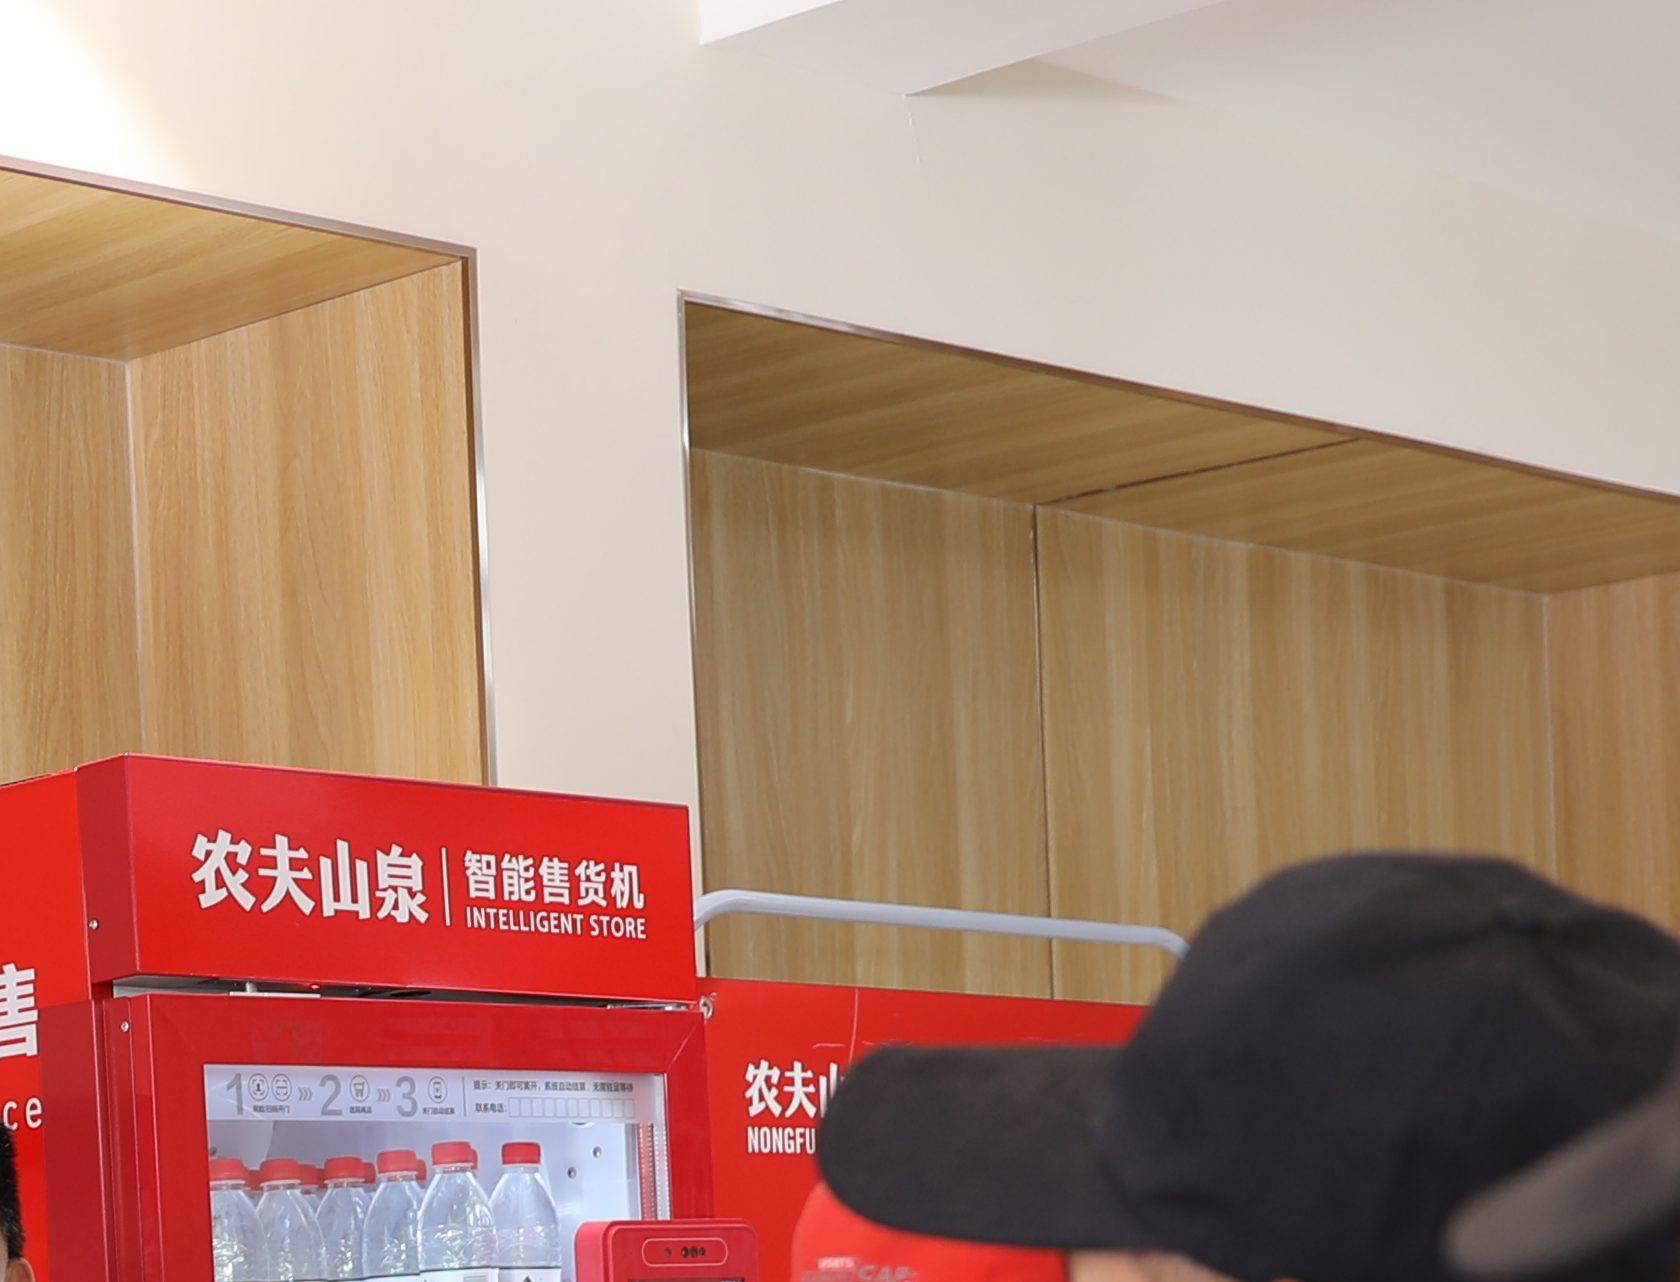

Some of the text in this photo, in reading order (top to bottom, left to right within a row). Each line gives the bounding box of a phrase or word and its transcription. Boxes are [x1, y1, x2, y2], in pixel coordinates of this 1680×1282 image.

[190, 828, 429, 926] 农夫山泉
[463, 847, 646, 912] 智能售货机
[465, 906, 647, 939] INTELLIGENT STORE
[320, 1074, 343, 1117] 2
[396, 1075, 418, 1117] 3
[747, 1127, 816, 1154] NONGFU
